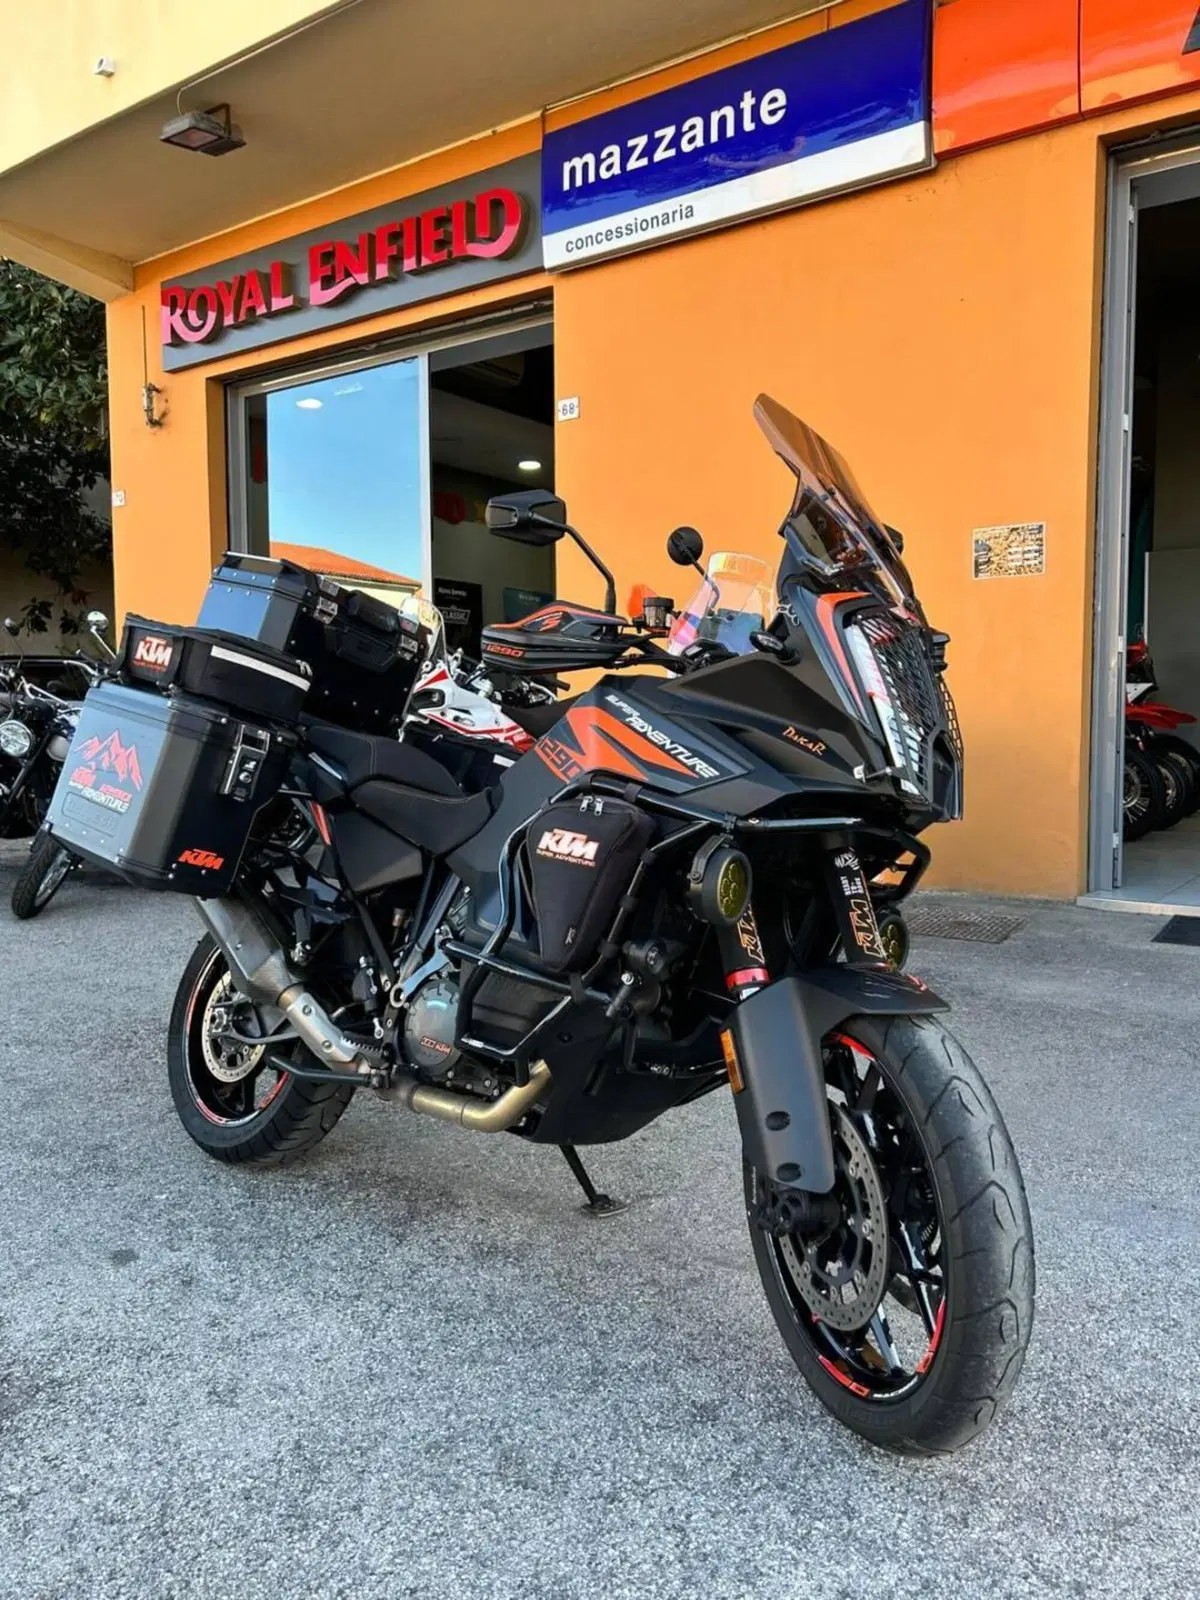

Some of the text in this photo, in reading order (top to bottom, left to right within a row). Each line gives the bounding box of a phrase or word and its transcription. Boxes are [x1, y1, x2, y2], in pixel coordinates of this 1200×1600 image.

[562, 88, 787, 191] mazzante
[565, 203, 695, 253] concessionaria
[161, 187, 522, 345] ROYAL ENFIELD
[134, 636, 173, 667] KTM
[486, 645, 525, 658] 1290
[605, 694, 641, 717] SUPER
[625, 714, 720, 779] ADVENTURE
[178, 848, 225, 870] KTM
[538, 828, 600, 861] KTM
[849, 899, 884, 958] KTM
